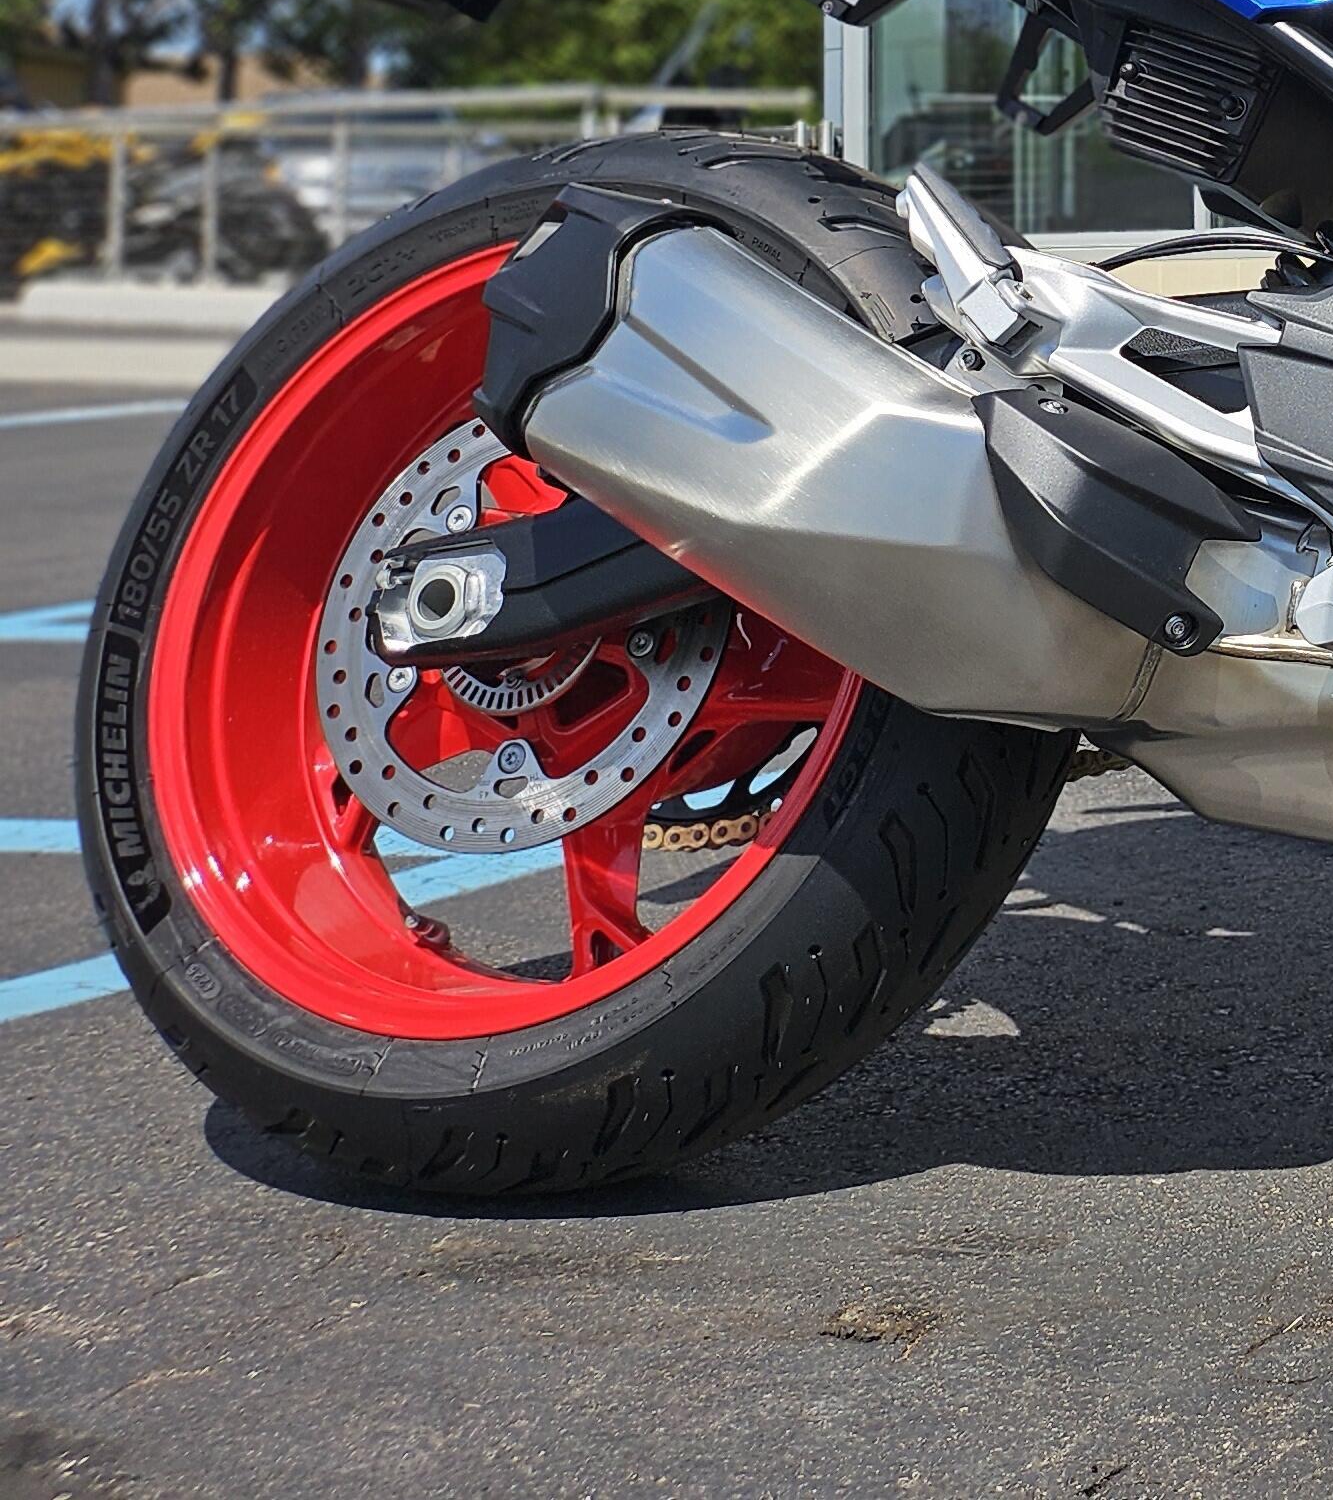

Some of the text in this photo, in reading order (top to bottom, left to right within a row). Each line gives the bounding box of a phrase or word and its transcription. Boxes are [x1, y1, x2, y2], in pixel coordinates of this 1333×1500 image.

[117, 488, 183, 631] 180/55
[171, 421, 217, 483] ZR
[210, 384, 245, 434] 17
[106, 654, 151, 861] MICHELIN
